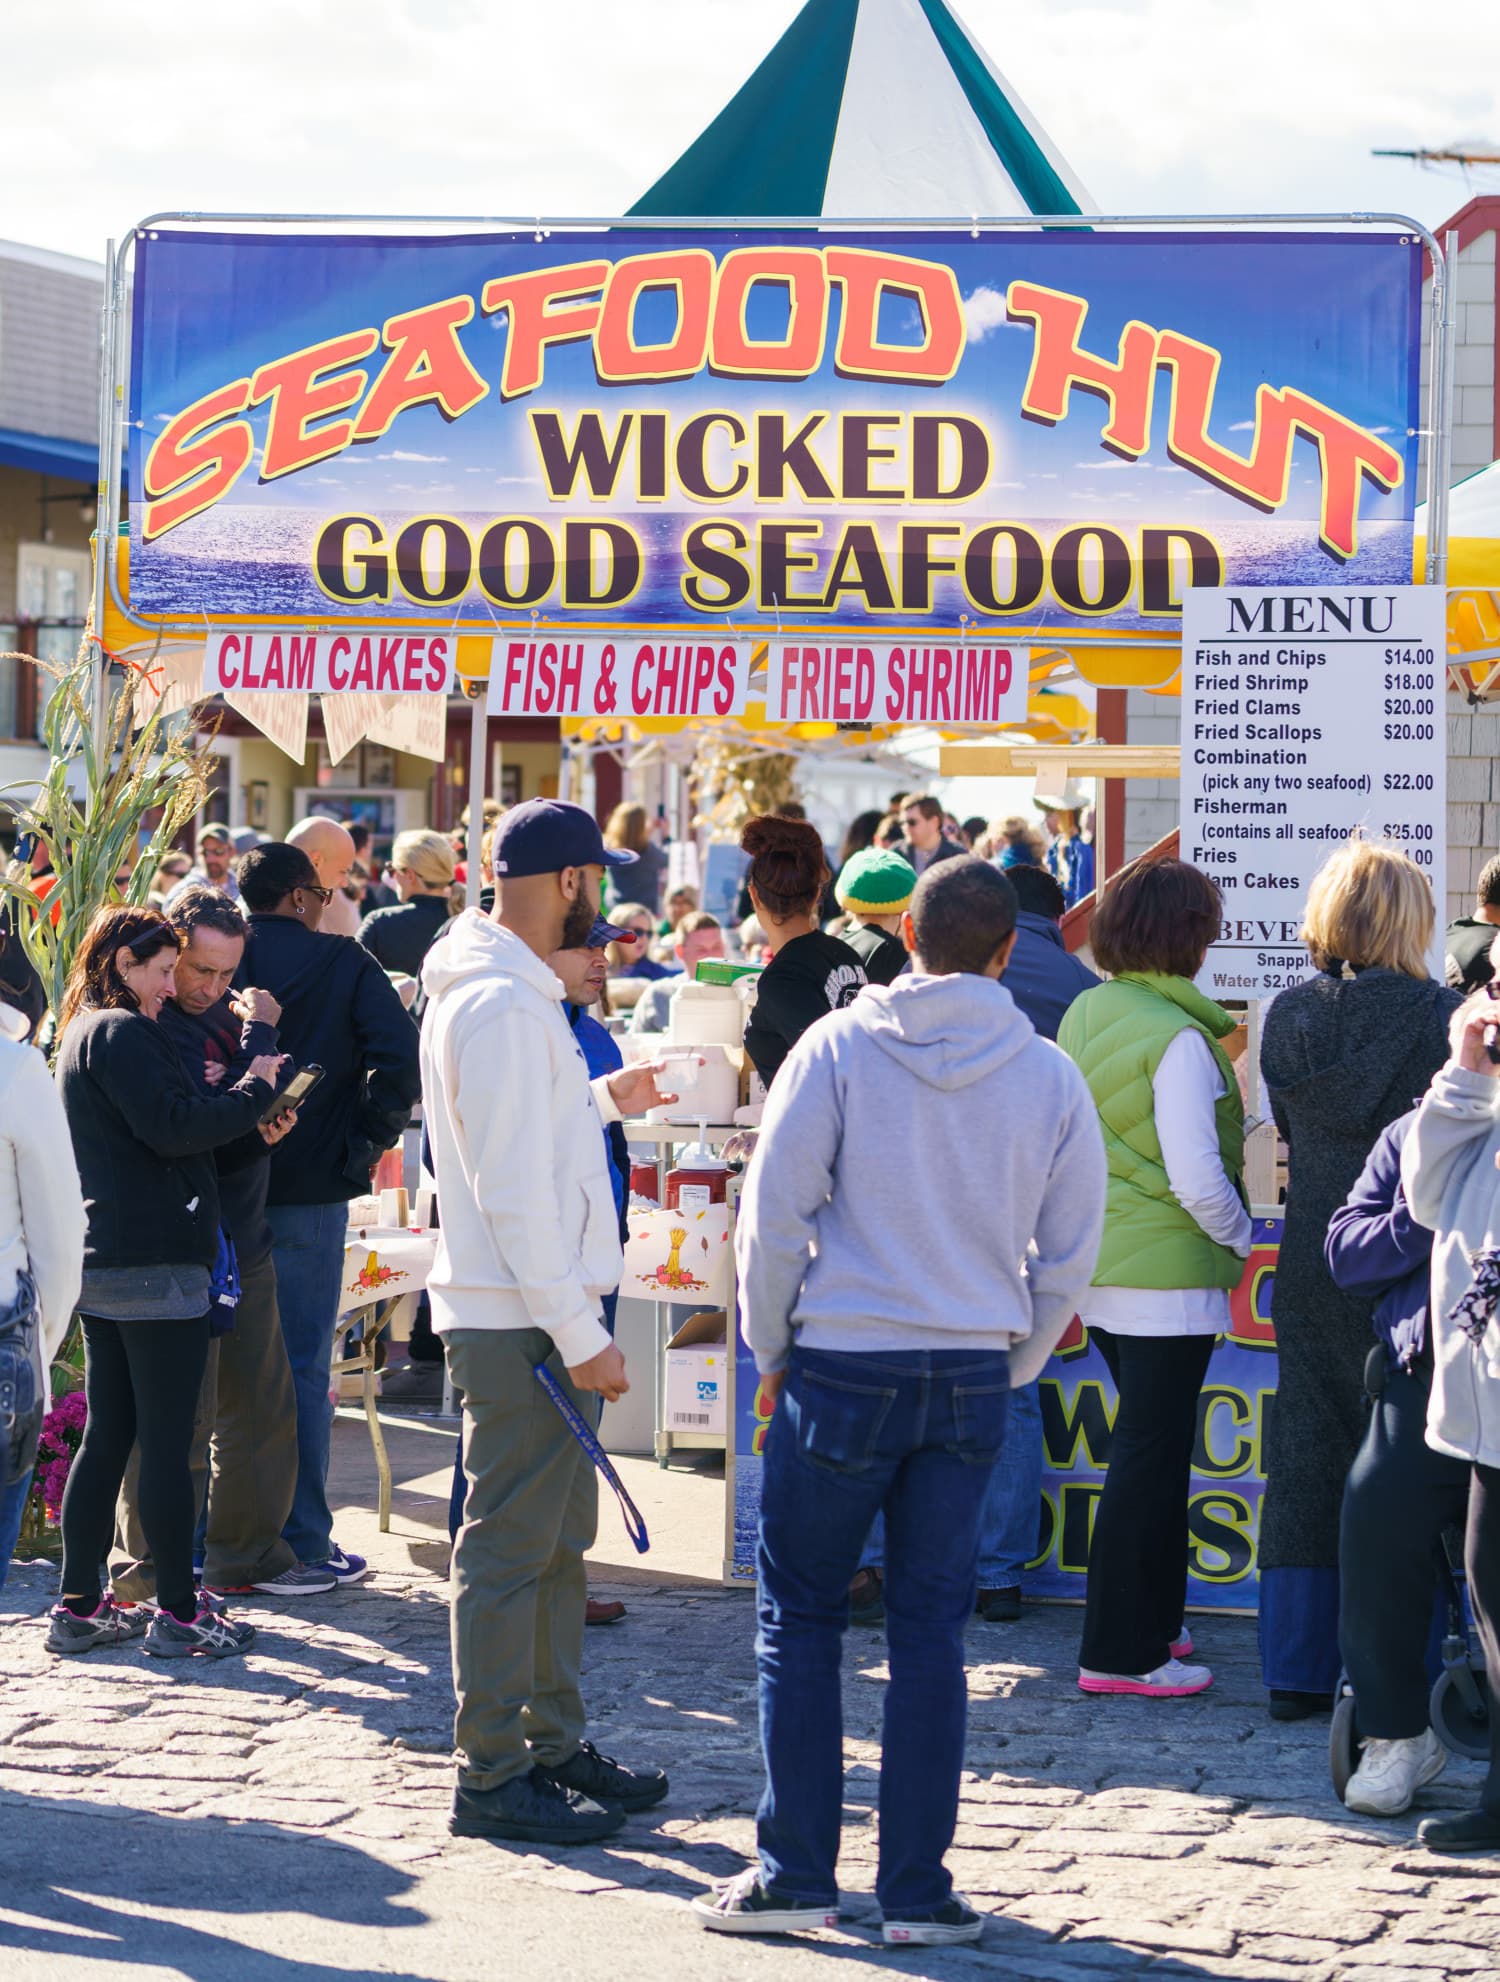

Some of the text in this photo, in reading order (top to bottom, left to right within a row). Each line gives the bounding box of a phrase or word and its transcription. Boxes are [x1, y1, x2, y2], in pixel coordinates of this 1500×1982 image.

[143, 246, 1404, 563] SEAFOOD HUT
[528, 409, 994, 504] WICKED
[313, 514, 1226, 618] GOOD SEAFOOD
[1225, 596, 1397, 634] MENU
[218, 635, 447, 692] CLAM CAKES
[1195, 648, 1434, 670] Fish and Chips $14.00
[502, 643, 737, 716] FISH & CHIPS
[781, 647, 1013, 721] FRIED SHRIMP
[1195, 673, 1434, 694] Fried Shrimp $18.00
[1194, 698, 1434, 716] Fried Clams $20.00
[1194, 723, 1434, 744] Fried Scallops $20.00
[1194, 748, 1307, 765] Combination
[1202, 773, 1434, 795] (pick any two seafood) $22.00
[1194, 798, 1288, 815] Fisherman
[1202, 822, 1271, 843] (contains
[1275, 823, 1294, 840] all
[1383, 823, 1433, 841] $25.00
[1193, 847, 1237, 864] Fries
[1243, 873, 1300, 890] Cakes
[1216, 920, 1302, 943] BEVE
[1212, 973, 1305, 990] Water $2.00
